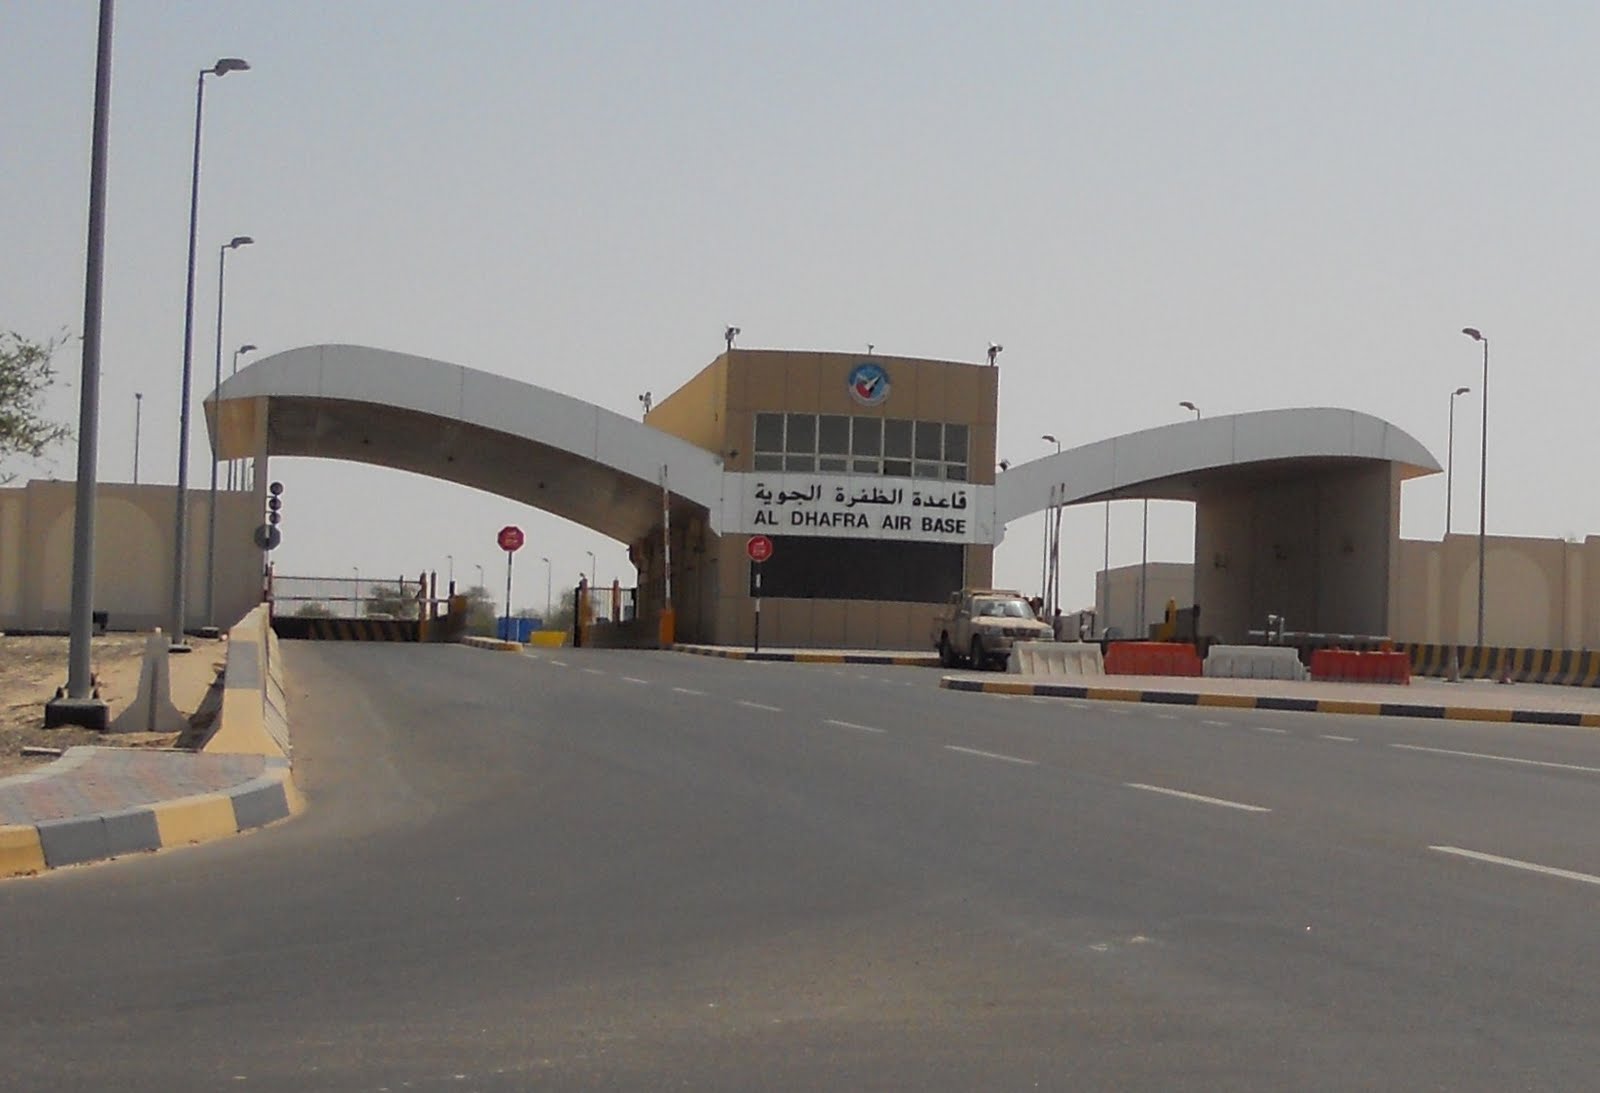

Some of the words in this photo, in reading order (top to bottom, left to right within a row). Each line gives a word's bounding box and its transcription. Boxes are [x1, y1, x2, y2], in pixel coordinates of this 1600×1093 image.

[755, 483, 822, 506] الجوية
[835, 487, 903, 508] الظفرة
[912, 491, 967, 509] قاعدة
[754, 510, 779, 525] AL
[791, 511, 869, 528] DHAFRA
[882, 515, 912, 530] AIR
[922, 517, 966, 534] BASE
